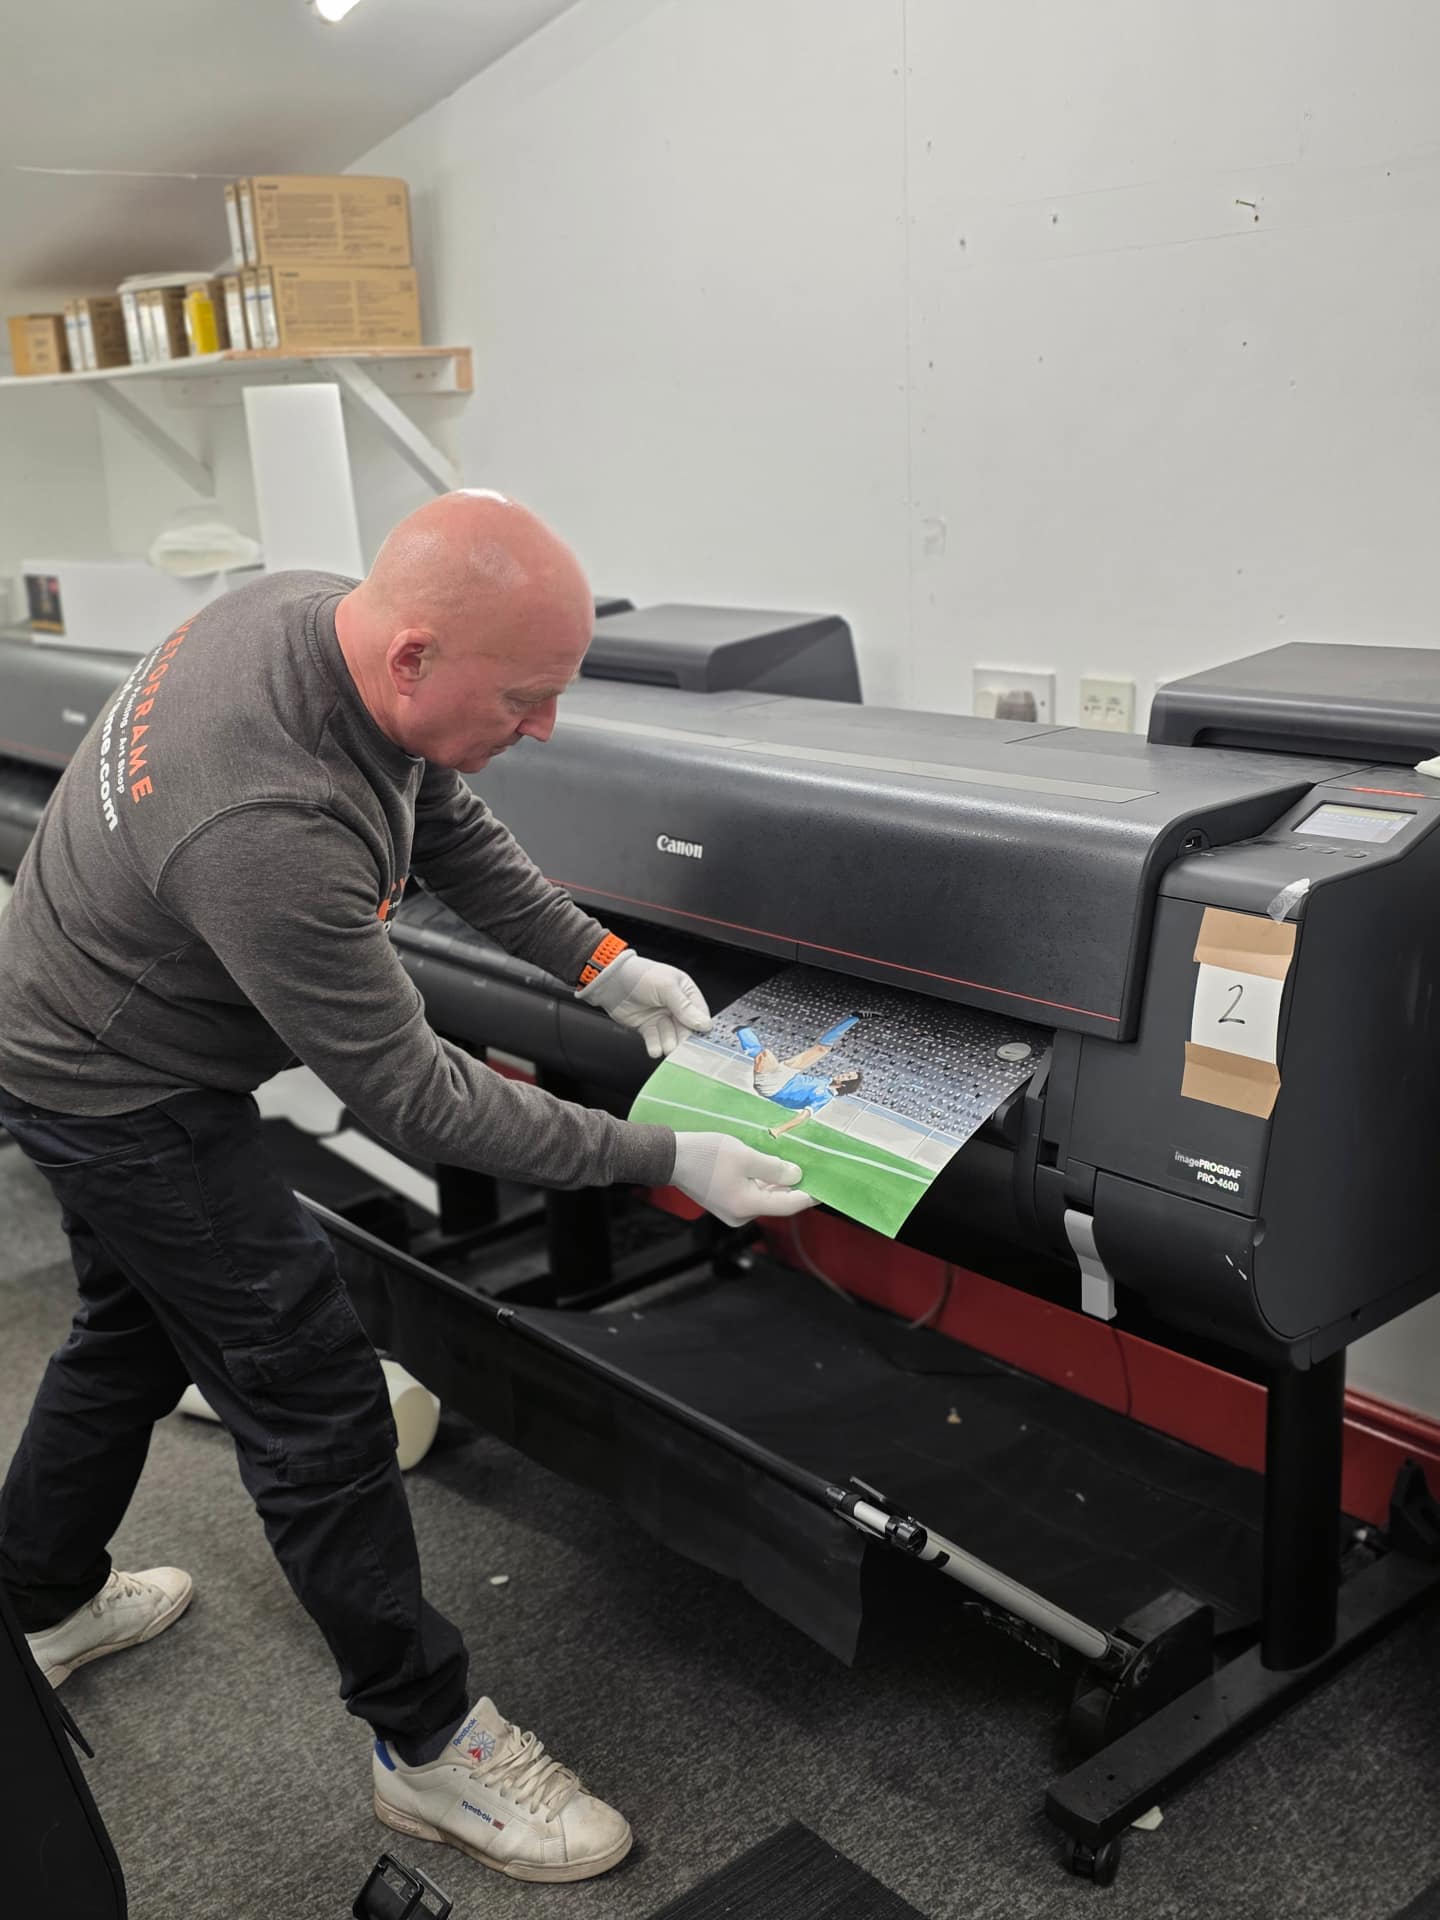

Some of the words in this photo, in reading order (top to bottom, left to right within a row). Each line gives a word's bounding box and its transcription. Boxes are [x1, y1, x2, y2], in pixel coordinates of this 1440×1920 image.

[130, 611, 198, 804] VETOFRAME
[656, 834, 703, 859] Canon
[1218, 984, 1245, 1024] 2
[1174, 1151, 1242, 1179] imagePROGRAF
[1196, 1171, 1240, 1193] PRO-4600
[453, 1717, 477, 1746] Reebok
[462, 1800, 492, 1823] Reebok
